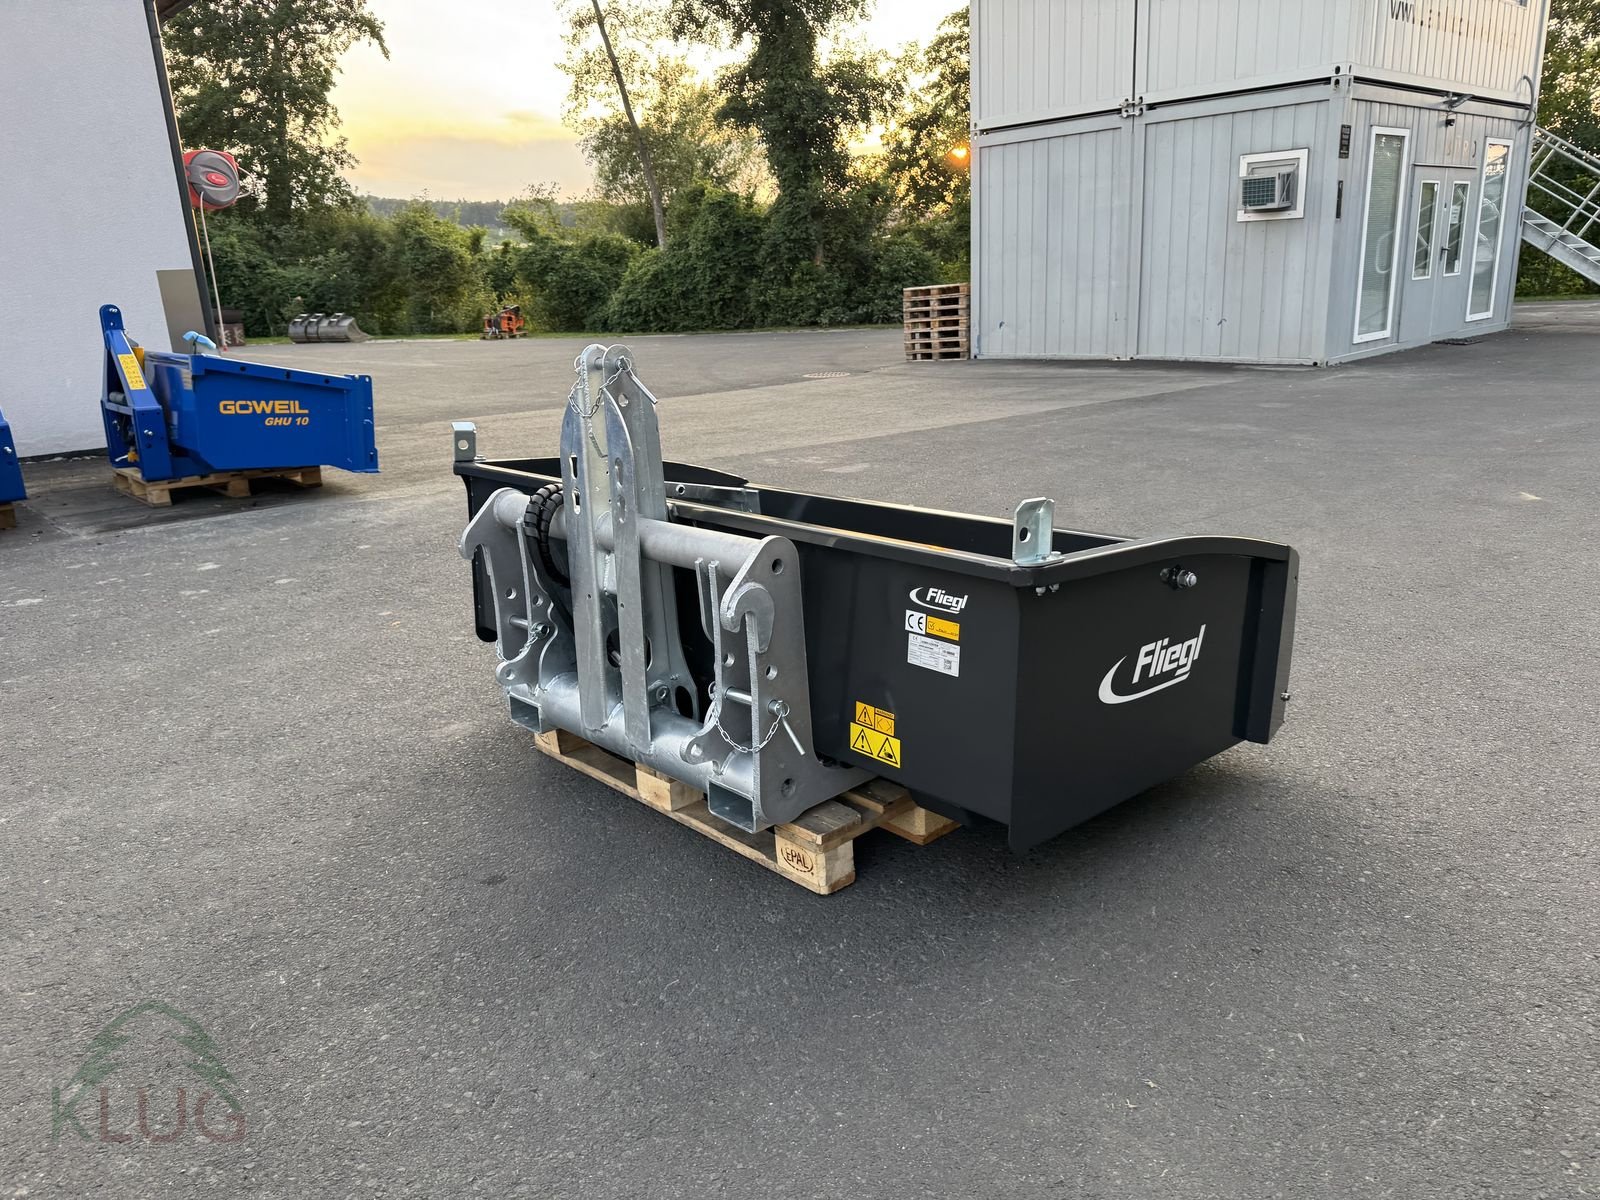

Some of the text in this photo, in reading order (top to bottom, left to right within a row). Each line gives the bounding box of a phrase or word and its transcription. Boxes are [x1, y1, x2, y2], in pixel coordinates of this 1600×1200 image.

[265, 417, 309, 426] GHU 10
[926, 588, 968, 612] Fliegl
[907, 613, 924, 631] CE
[1132, 624, 1206, 684] Fliegl
[786, 848, 809, 870] EPAL
